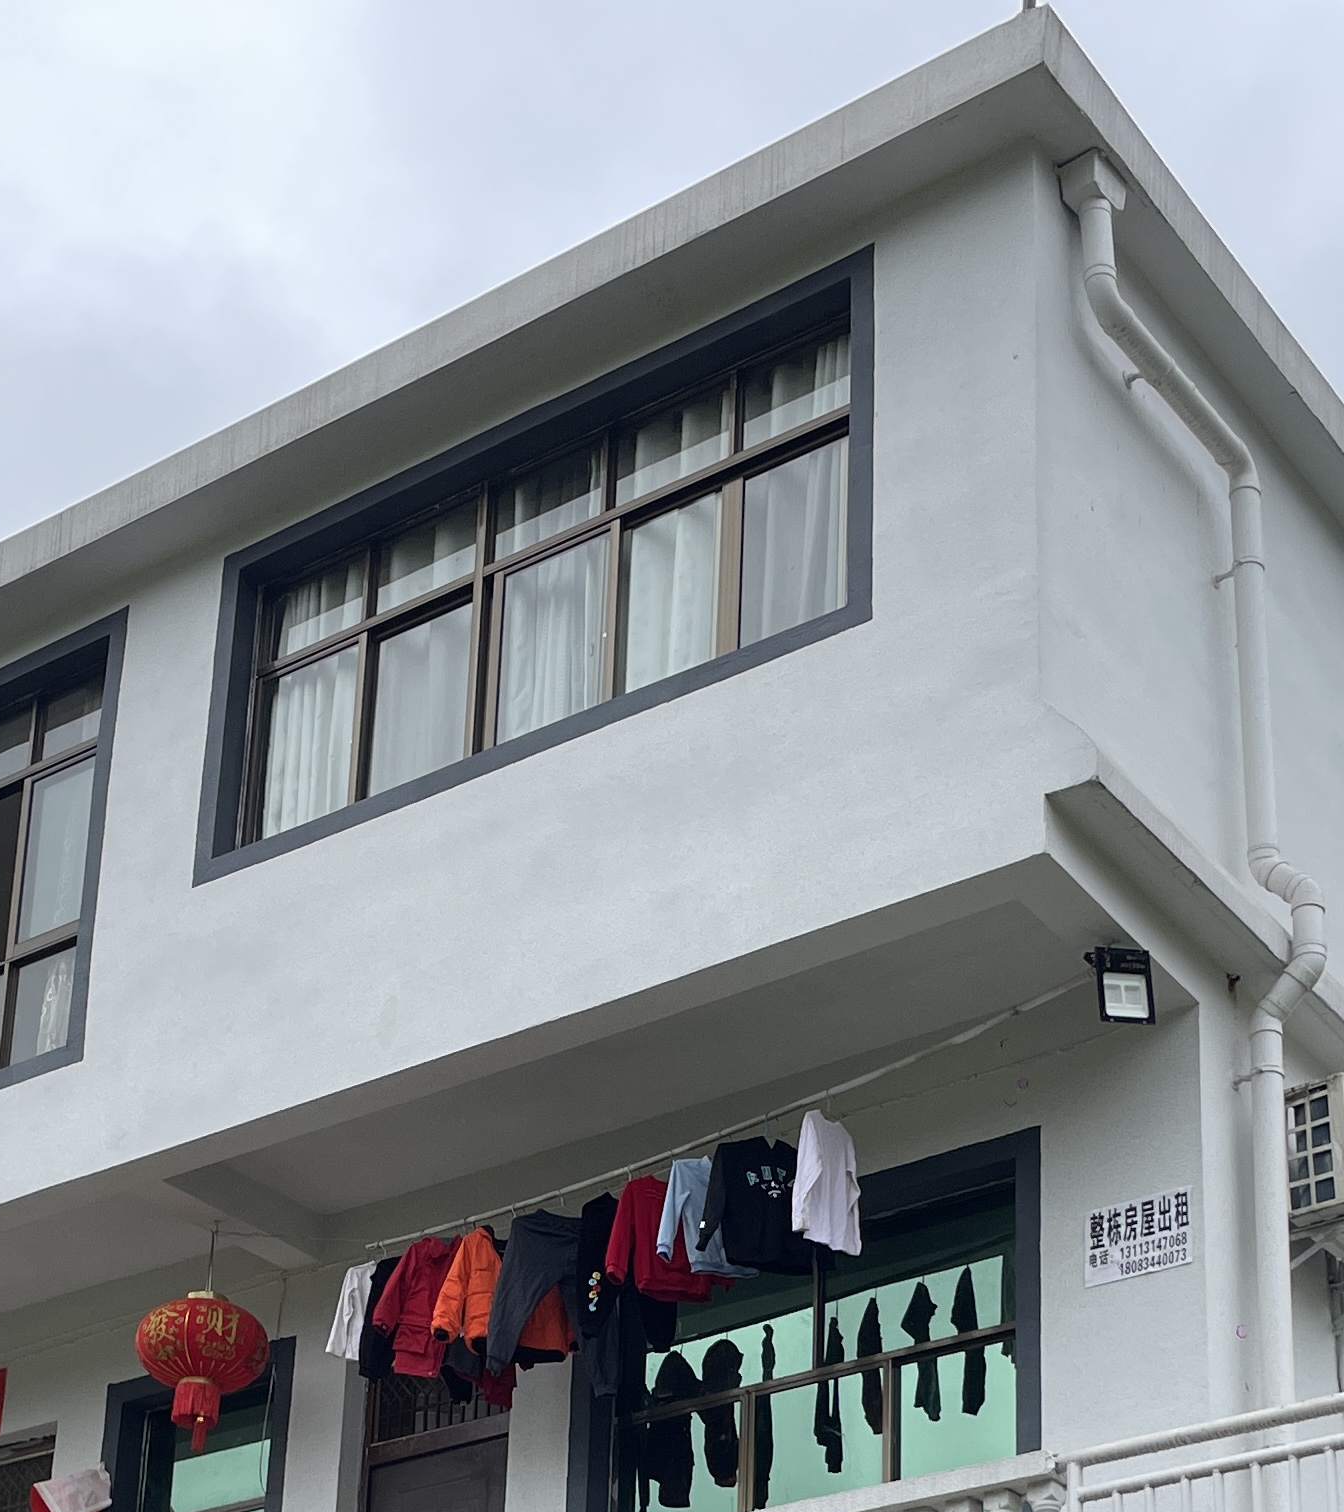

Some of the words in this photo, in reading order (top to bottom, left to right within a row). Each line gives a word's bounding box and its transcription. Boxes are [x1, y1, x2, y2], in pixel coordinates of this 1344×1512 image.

[1089, 1191, 1190, 1250] 整栋房屋出租
[1120, 1232, 1188, 1260] 13113147068
[1119, 1248, 1187, 1276] 18083440073
